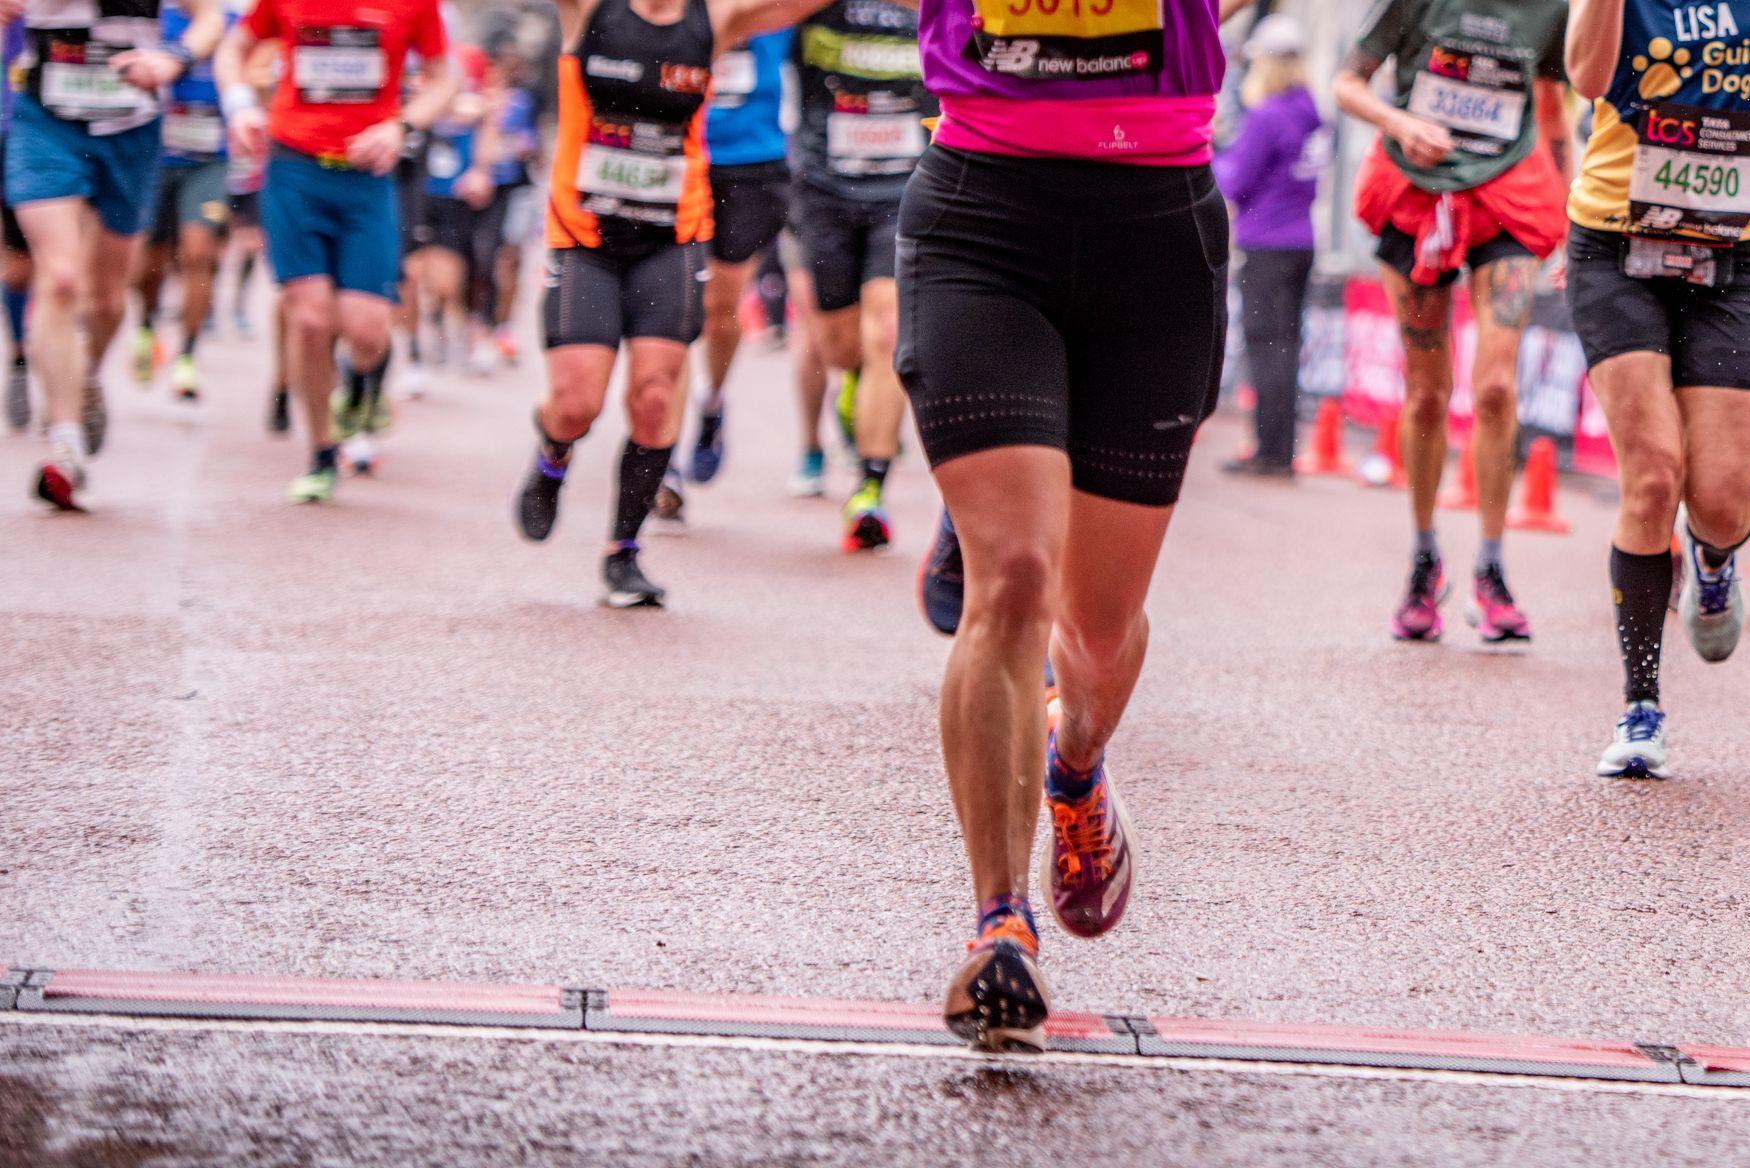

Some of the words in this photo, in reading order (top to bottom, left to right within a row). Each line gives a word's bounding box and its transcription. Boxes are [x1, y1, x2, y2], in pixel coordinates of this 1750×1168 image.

[1673, 2, 1739, 42] LISA
[1038, 60, 1074, 73] new
[1076, 55, 1133, 75] balanc
[1646, 109, 1696, 146] tcs
[1654, 160, 1739, 197] 44590
